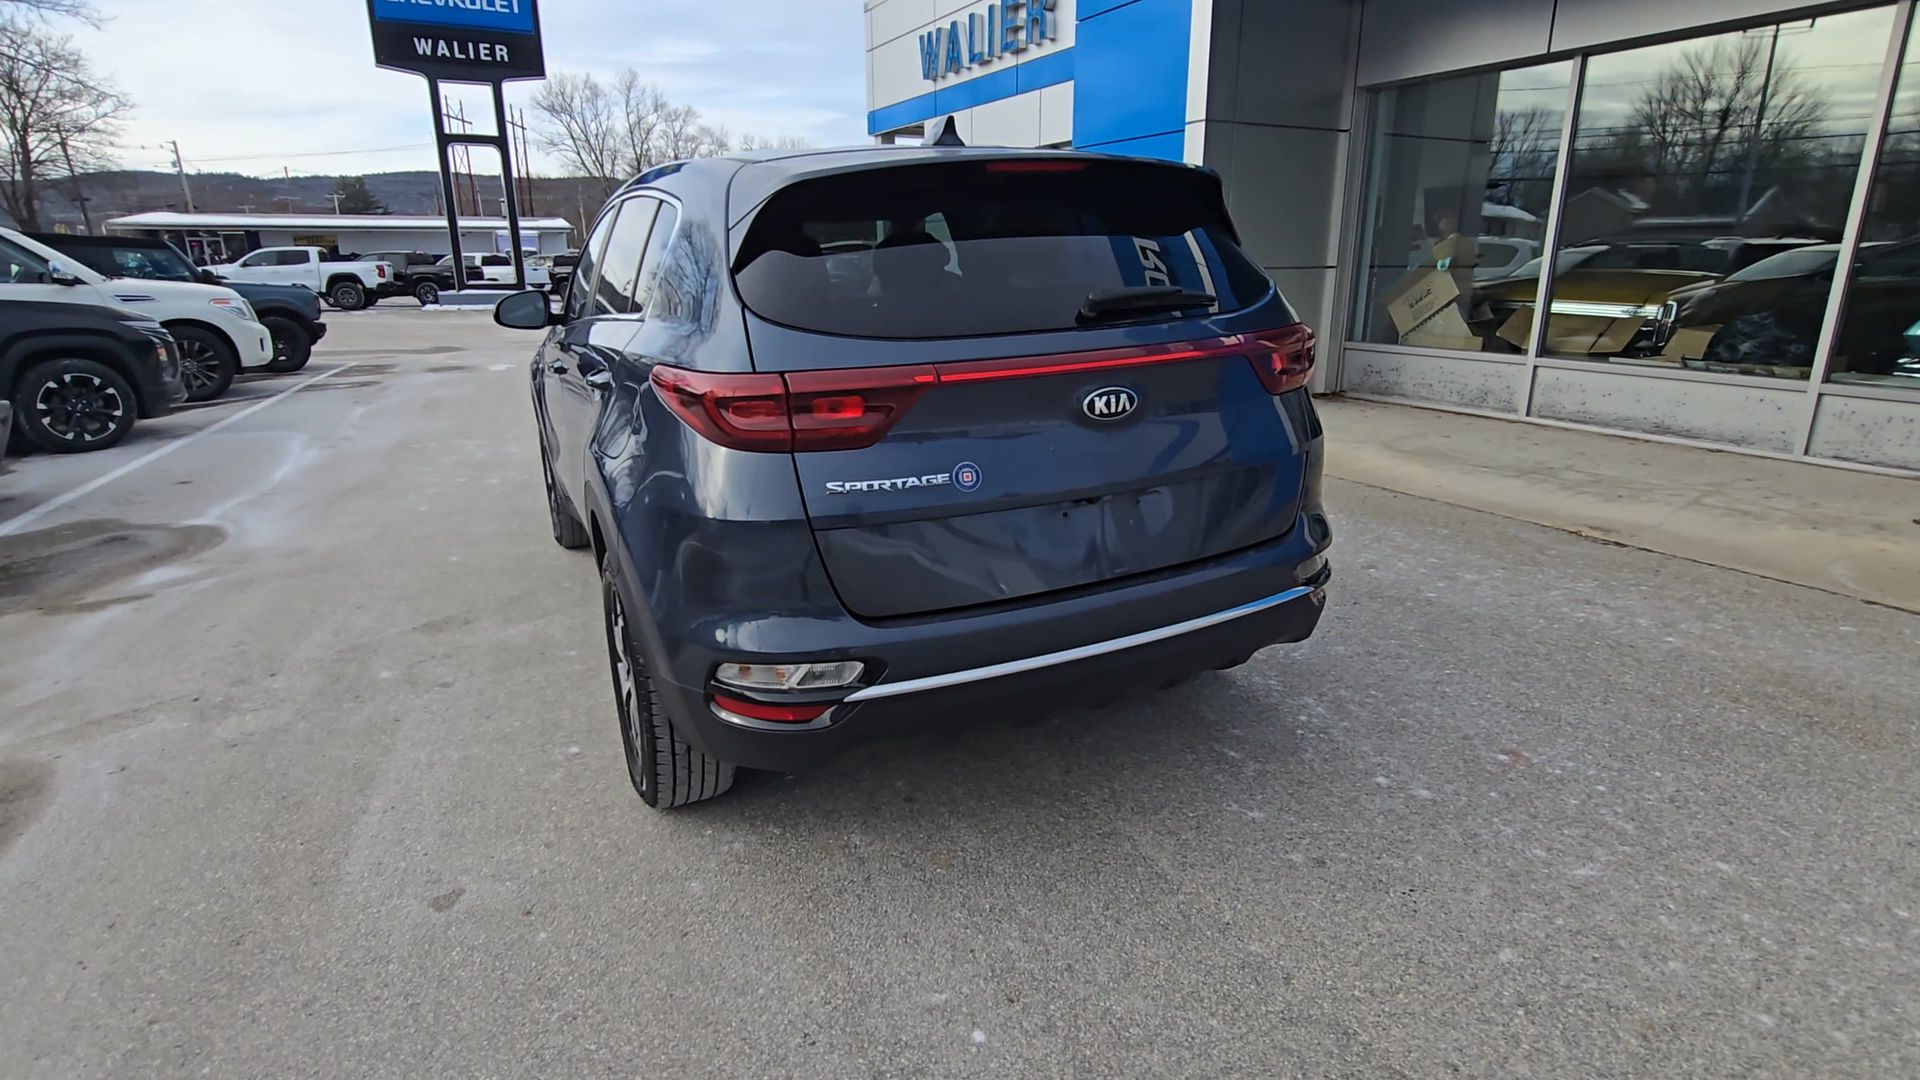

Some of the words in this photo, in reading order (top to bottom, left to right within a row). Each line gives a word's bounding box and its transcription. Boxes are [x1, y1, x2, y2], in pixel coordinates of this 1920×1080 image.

[413, 36, 509, 62] WALIER
[918, 0, 1057, 81] WALIER
[1093, 393, 1131, 415] KIA
[825, 473, 951, 495] SPORTAGE
